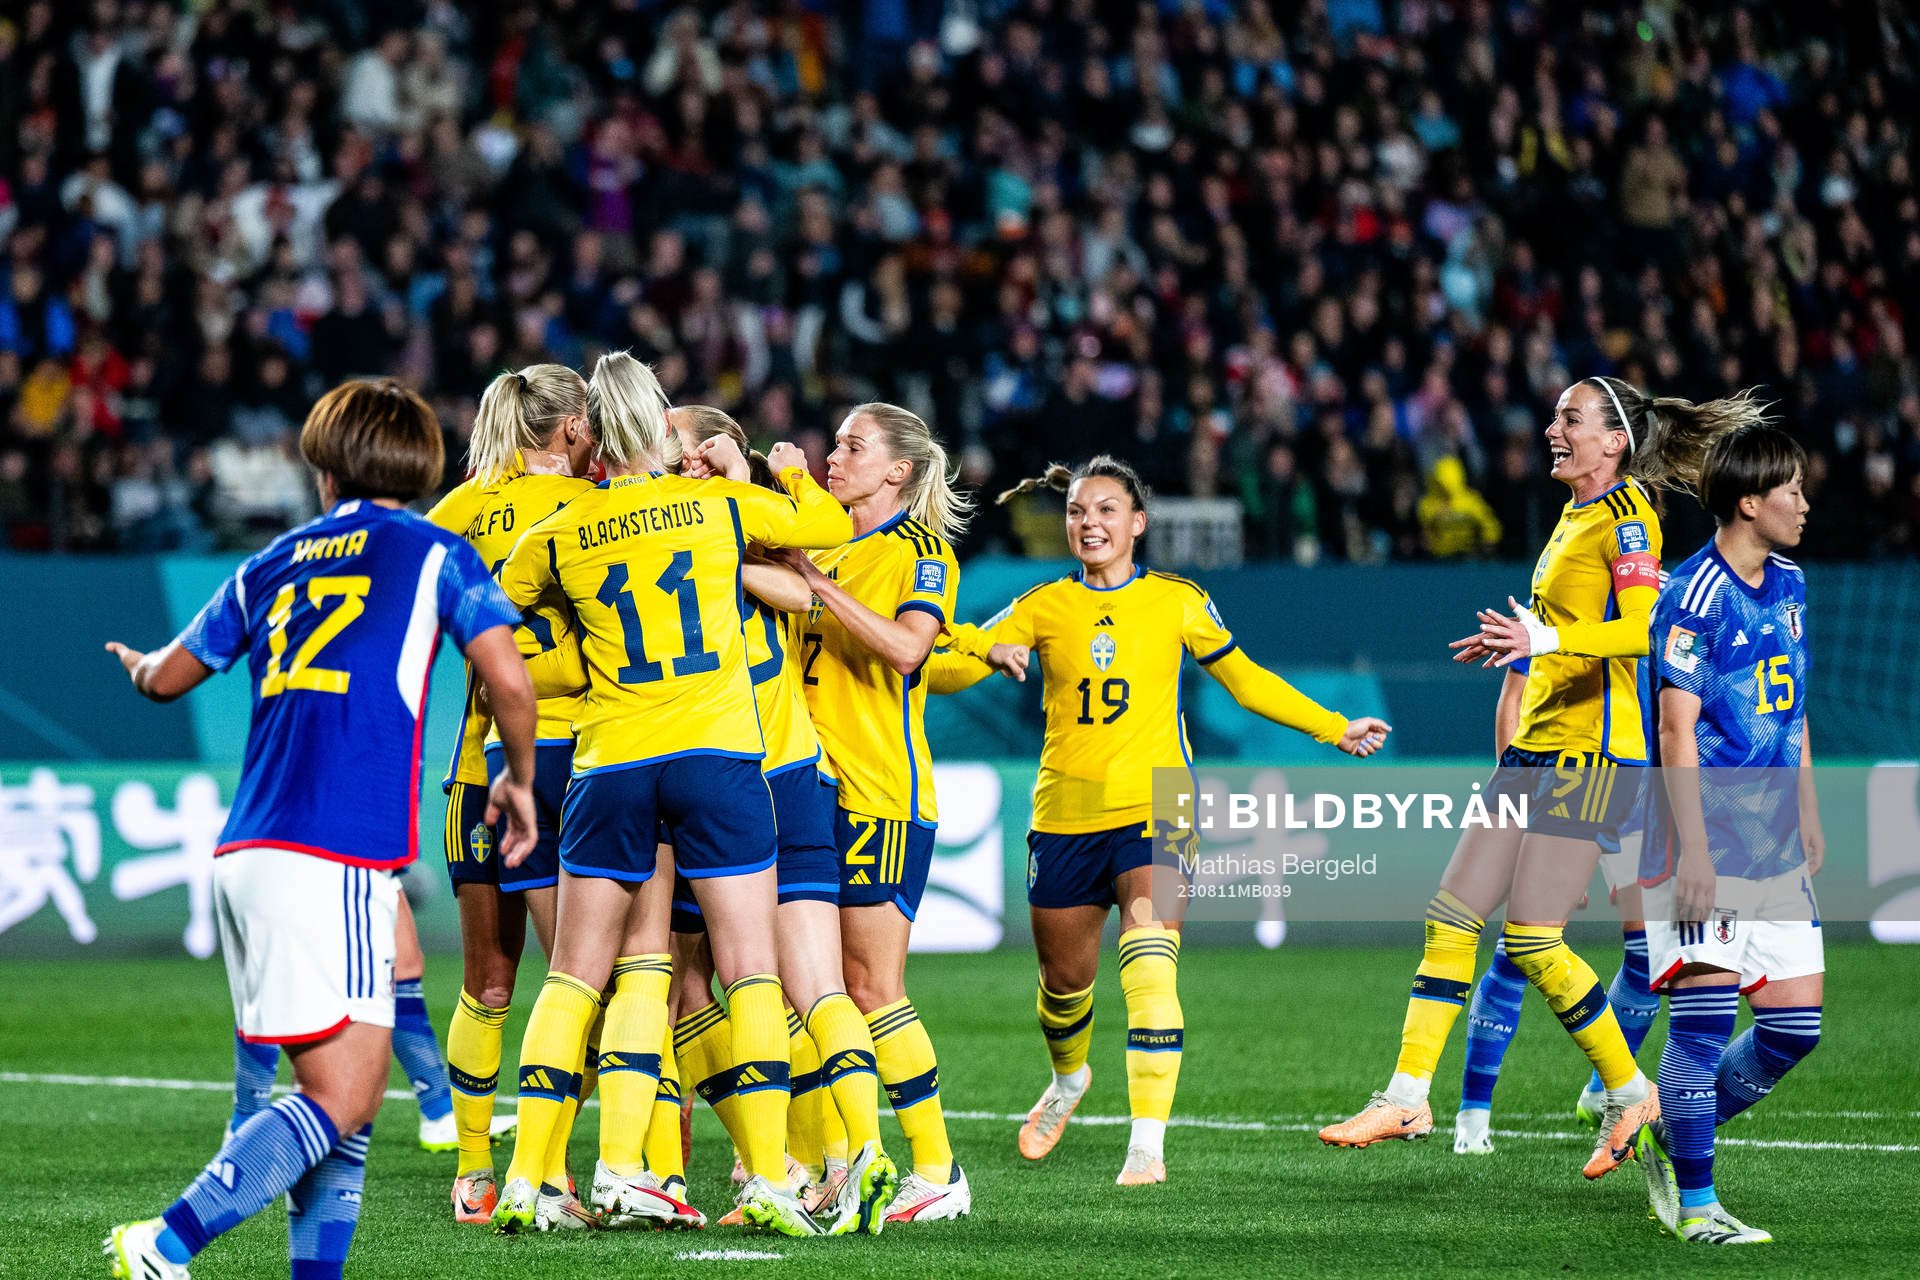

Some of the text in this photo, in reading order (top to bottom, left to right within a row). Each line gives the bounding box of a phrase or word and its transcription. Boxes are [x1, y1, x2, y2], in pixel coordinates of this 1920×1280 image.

[578, 500, 705, 551] BLACKSTENIUS
[260, 575, 371, 698] 12
[595, 550, 721, 684] 11
[1077, 677, 1130, 725] 19
[1754, 654, 1794, 715] 15
[1552, 749, 1587, 798] 9
[846, 812, 878, 865] 2
